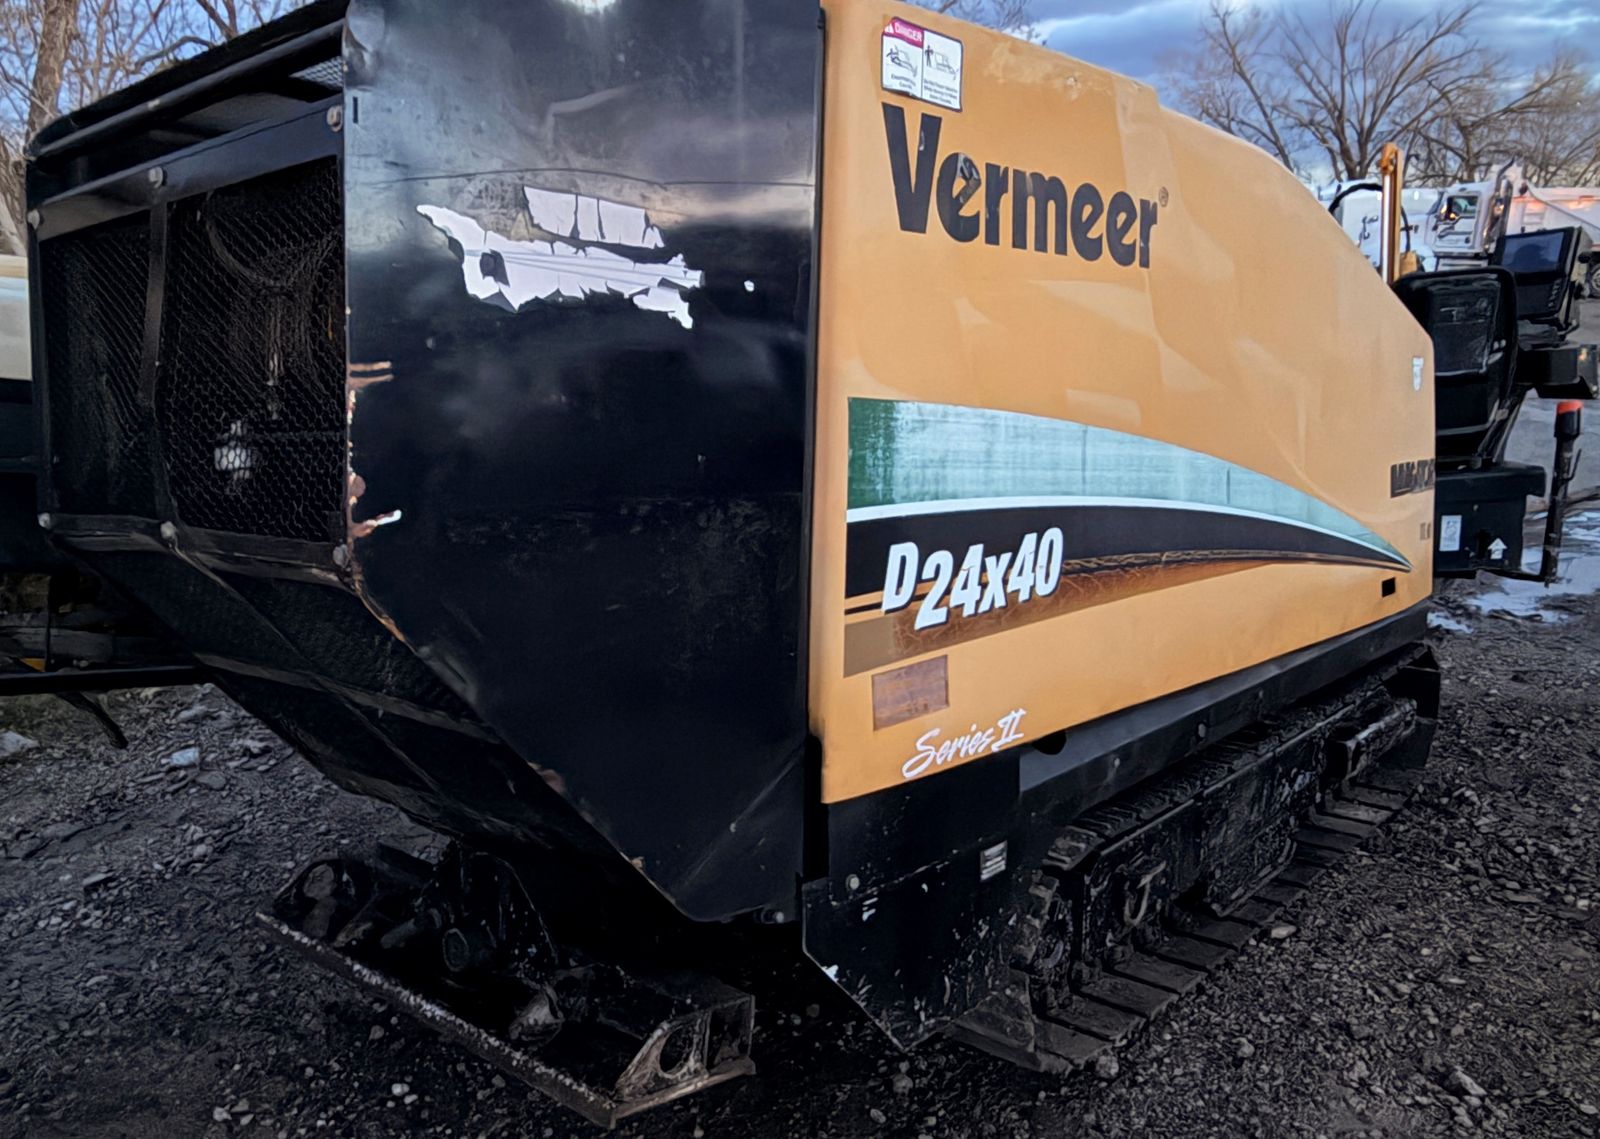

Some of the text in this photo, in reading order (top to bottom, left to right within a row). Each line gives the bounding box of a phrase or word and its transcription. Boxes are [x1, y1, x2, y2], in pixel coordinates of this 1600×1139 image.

[881, 101, 1157, 269] Vermeer
[881, 527, 1064, 630] D24x40
[902, 708, 1027, 778] Series II
